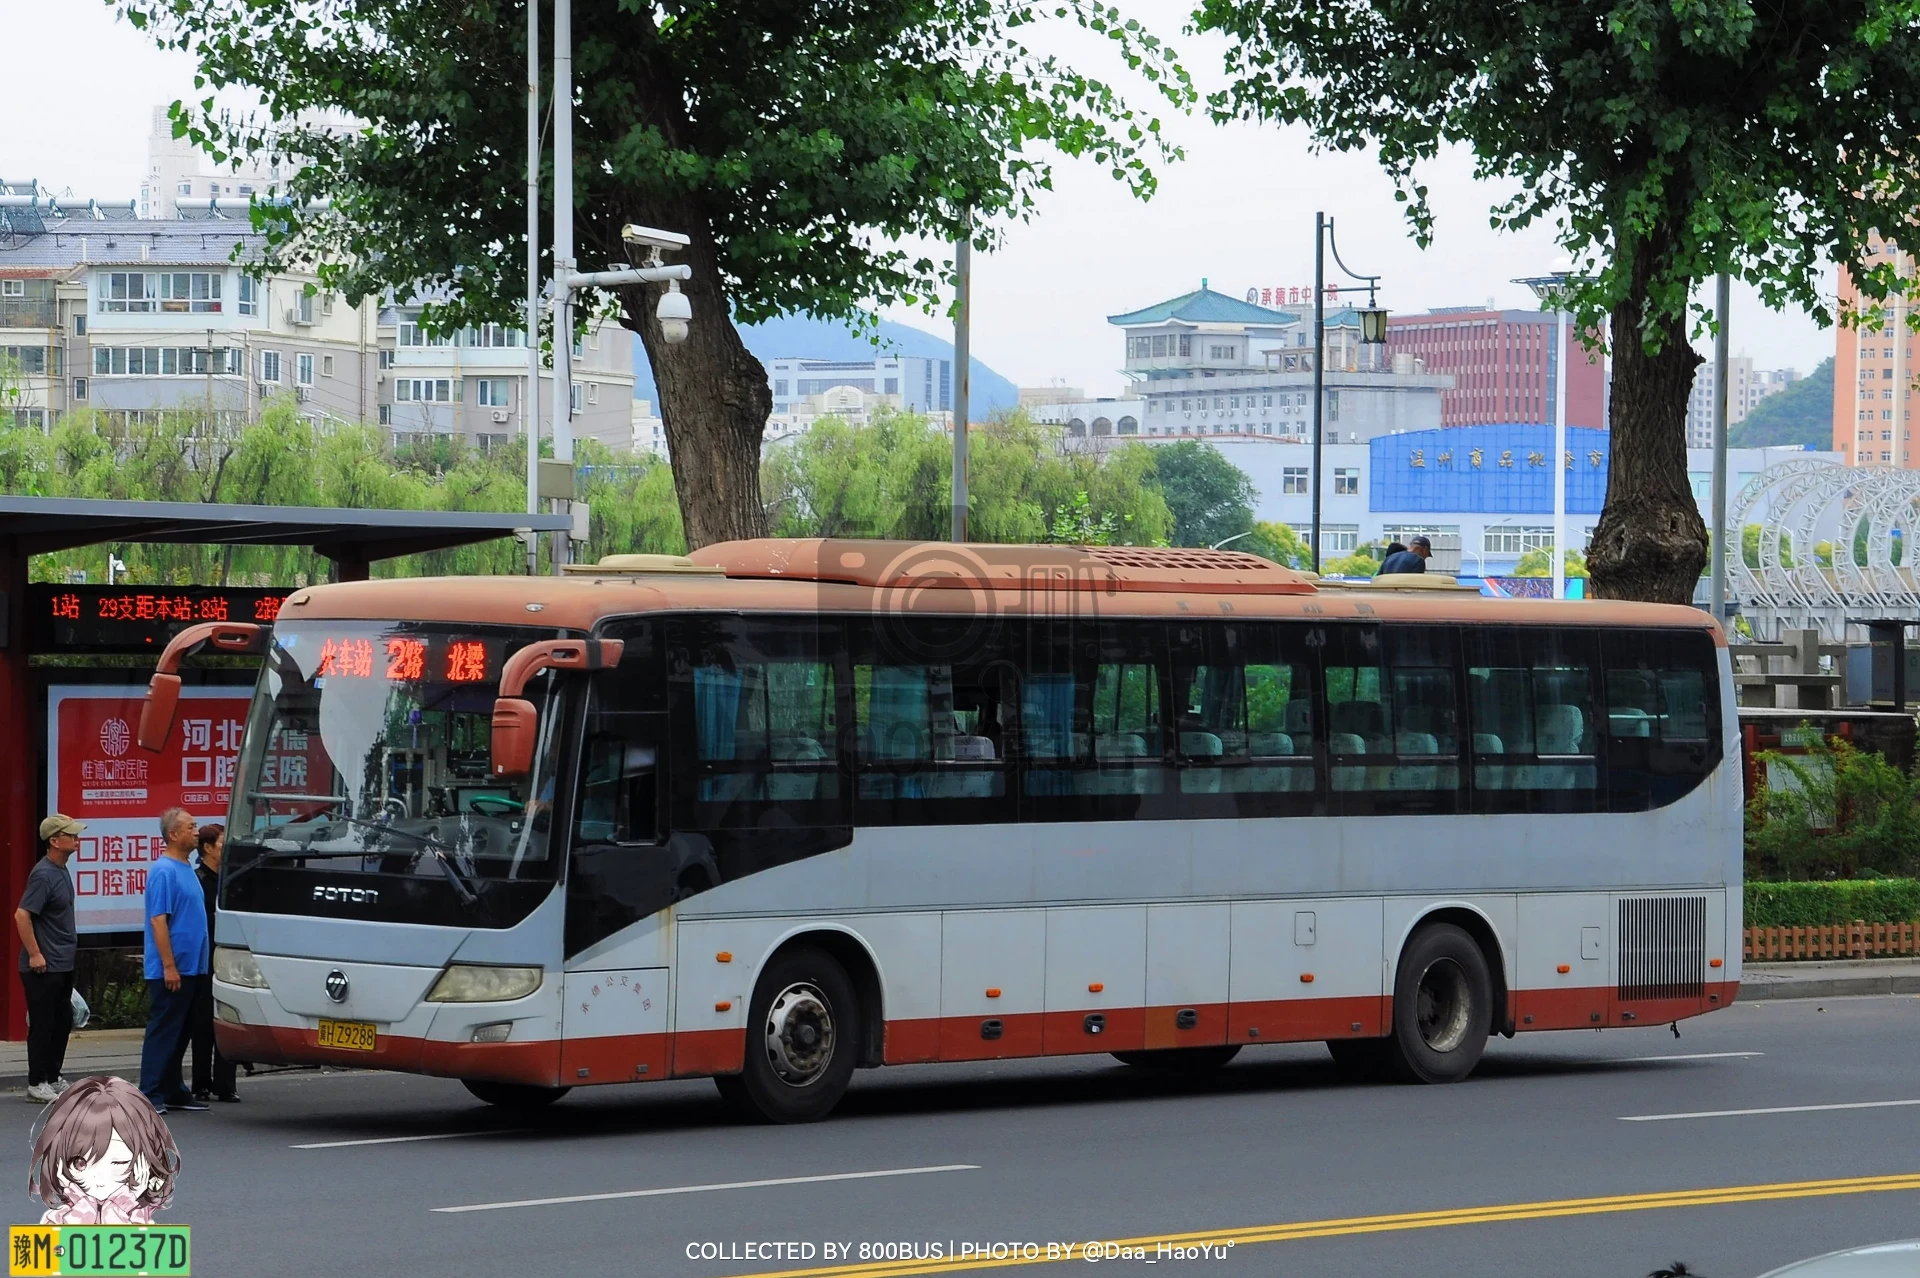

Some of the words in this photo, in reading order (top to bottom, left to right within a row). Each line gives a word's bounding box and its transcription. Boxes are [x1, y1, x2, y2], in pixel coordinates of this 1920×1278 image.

[1261, 283, 1338, 306] 承德市中院
[52, 594, 79, 619] 1站
[254, 596, 288, 621] 2路
[318, 637, 373, 678] 火车站
[386, 638, 424, 680] 2路
